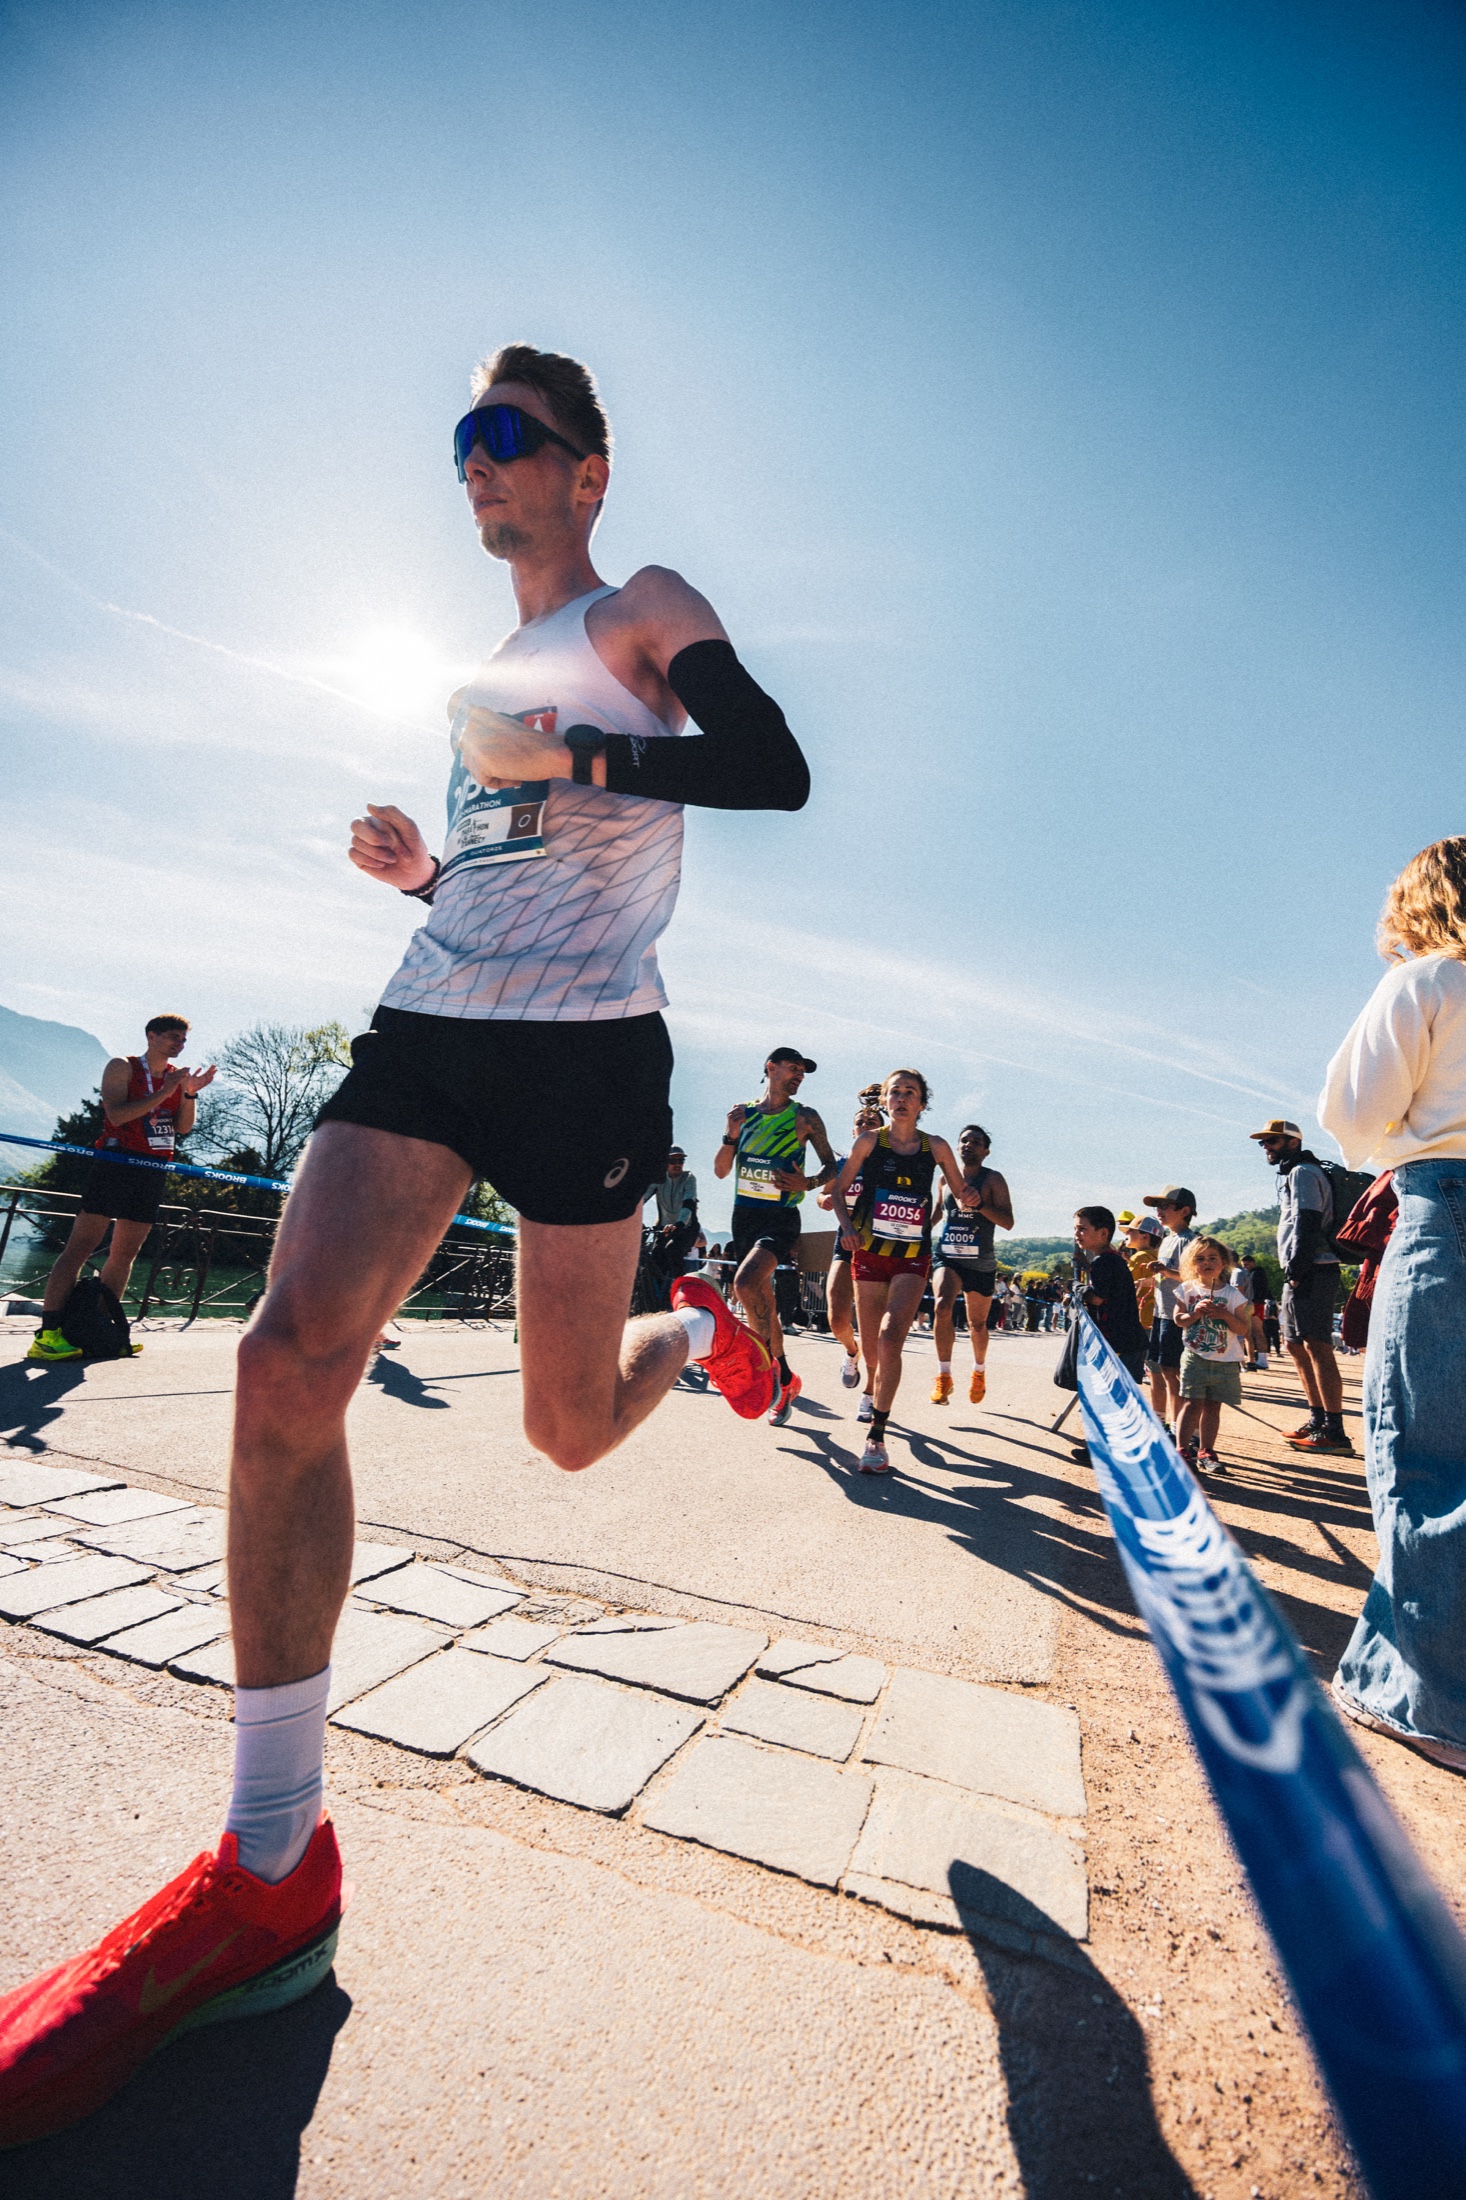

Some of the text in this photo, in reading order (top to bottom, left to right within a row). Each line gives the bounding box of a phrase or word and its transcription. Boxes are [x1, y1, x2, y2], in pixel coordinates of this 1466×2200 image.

[128, 1158, 176, 1171] BROOKS
[746, 1157, 771, 1165] BROOKS
[205, 1170, 247, 1185] BROOKS
[887, 1194, 917, 1204] BROOKS
[880, 1203, 921, 1221] 20056
[944, 1232, 975, 1243] 20009
